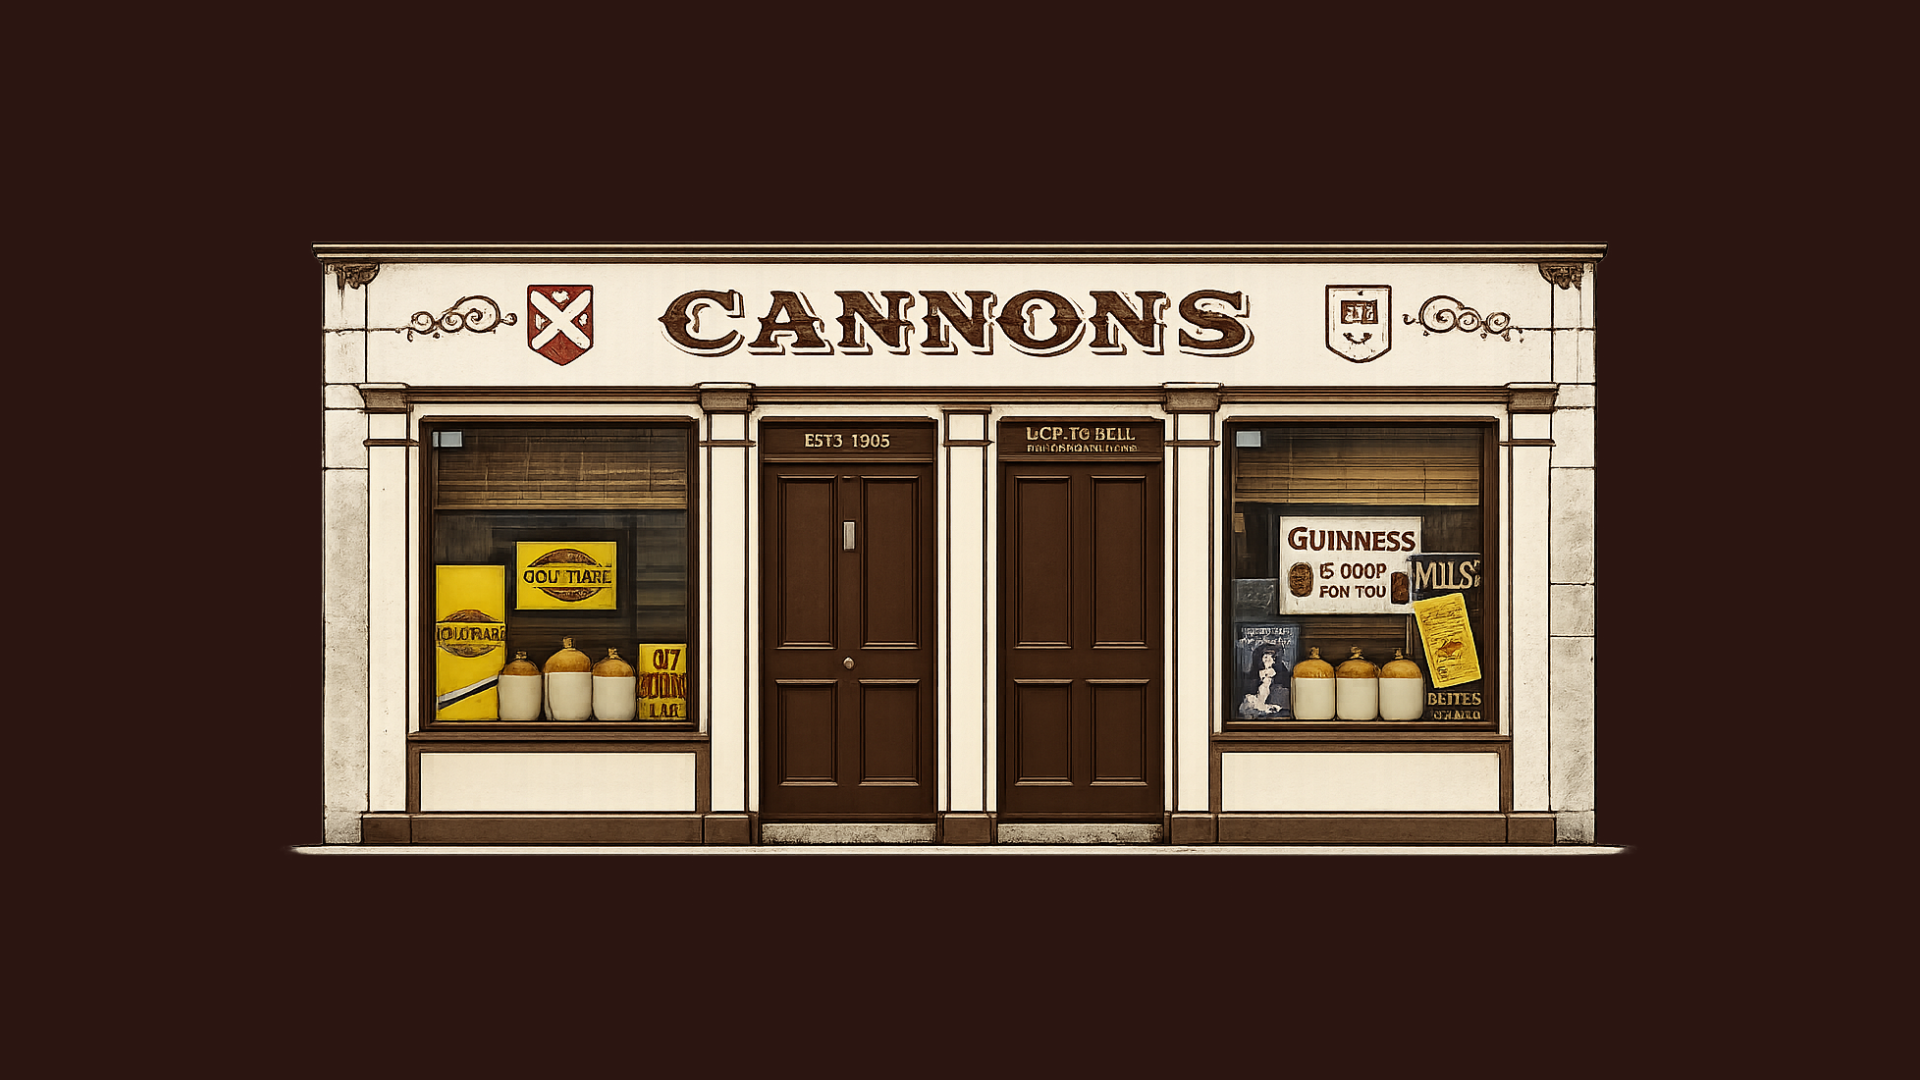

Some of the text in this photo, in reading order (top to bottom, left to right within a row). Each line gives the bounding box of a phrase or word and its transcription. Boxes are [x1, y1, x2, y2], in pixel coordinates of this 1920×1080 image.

[657, 289, 1255, 357] CANNONS
[851, 433, 890, 448] 1905
[1287, 526, 1416, 552] GUINNESS
[1319, 585, 1387, 598] FON TOU
